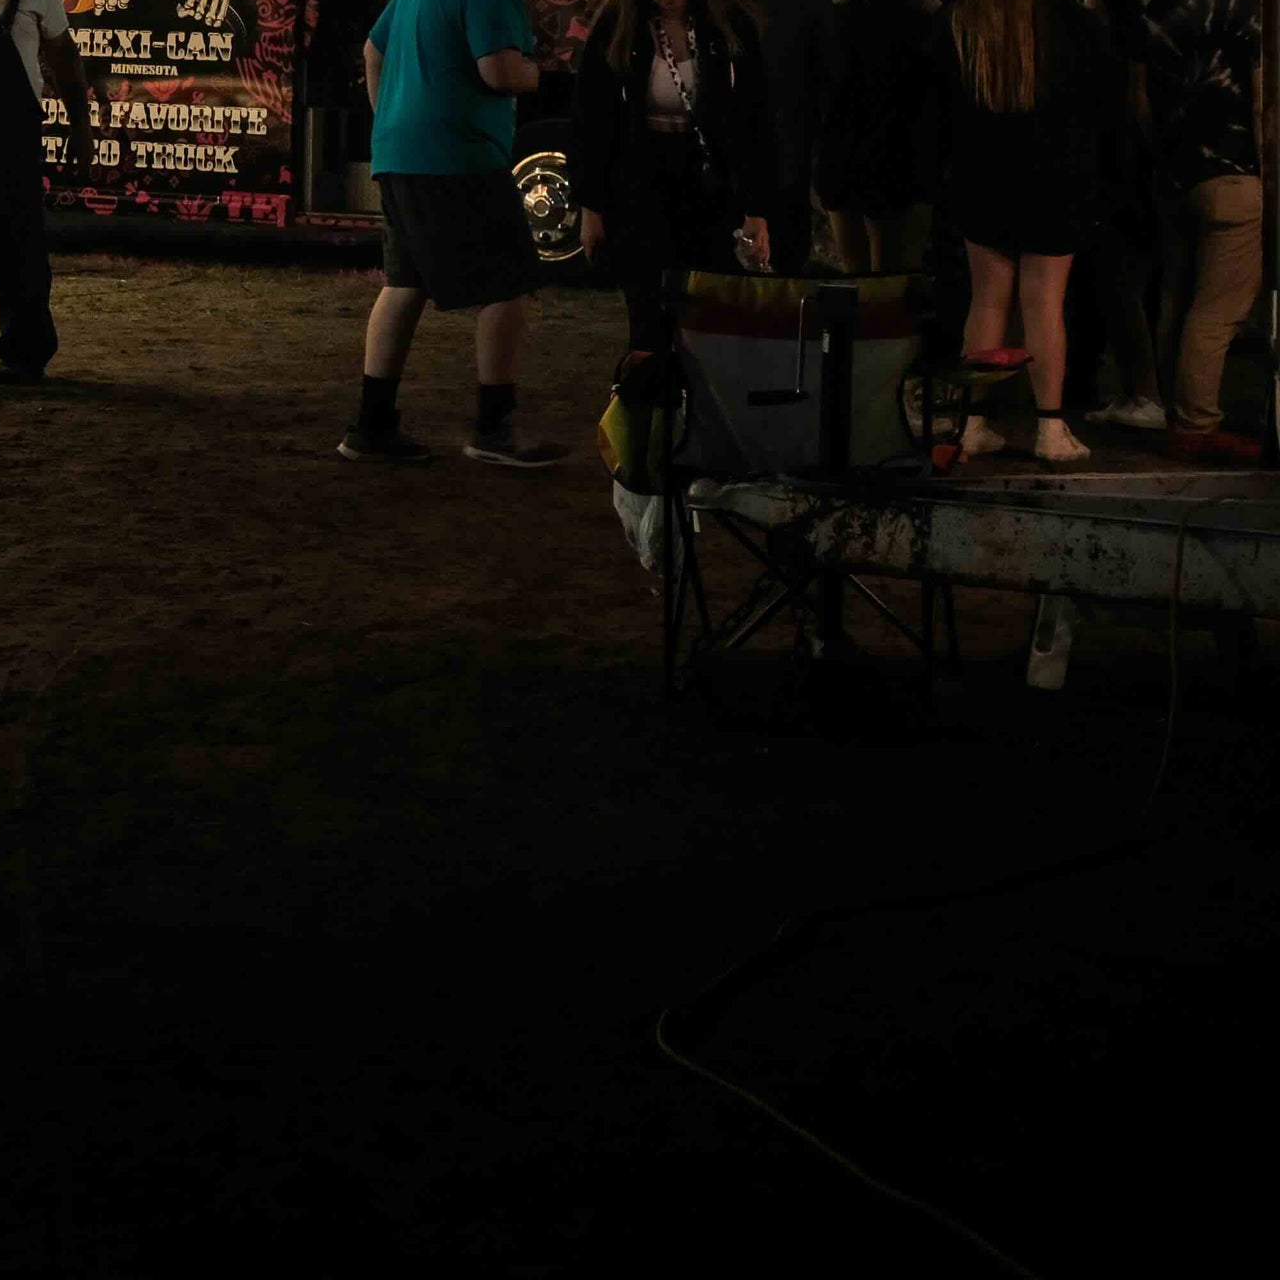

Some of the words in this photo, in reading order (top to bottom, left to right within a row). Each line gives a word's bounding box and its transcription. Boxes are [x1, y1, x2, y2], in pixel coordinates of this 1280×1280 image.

[110, 63, 178, 76] MINNESOTA
[109, 101, 268, 135] FAVORITE
[130, 140, 239, 173] TRUCK
